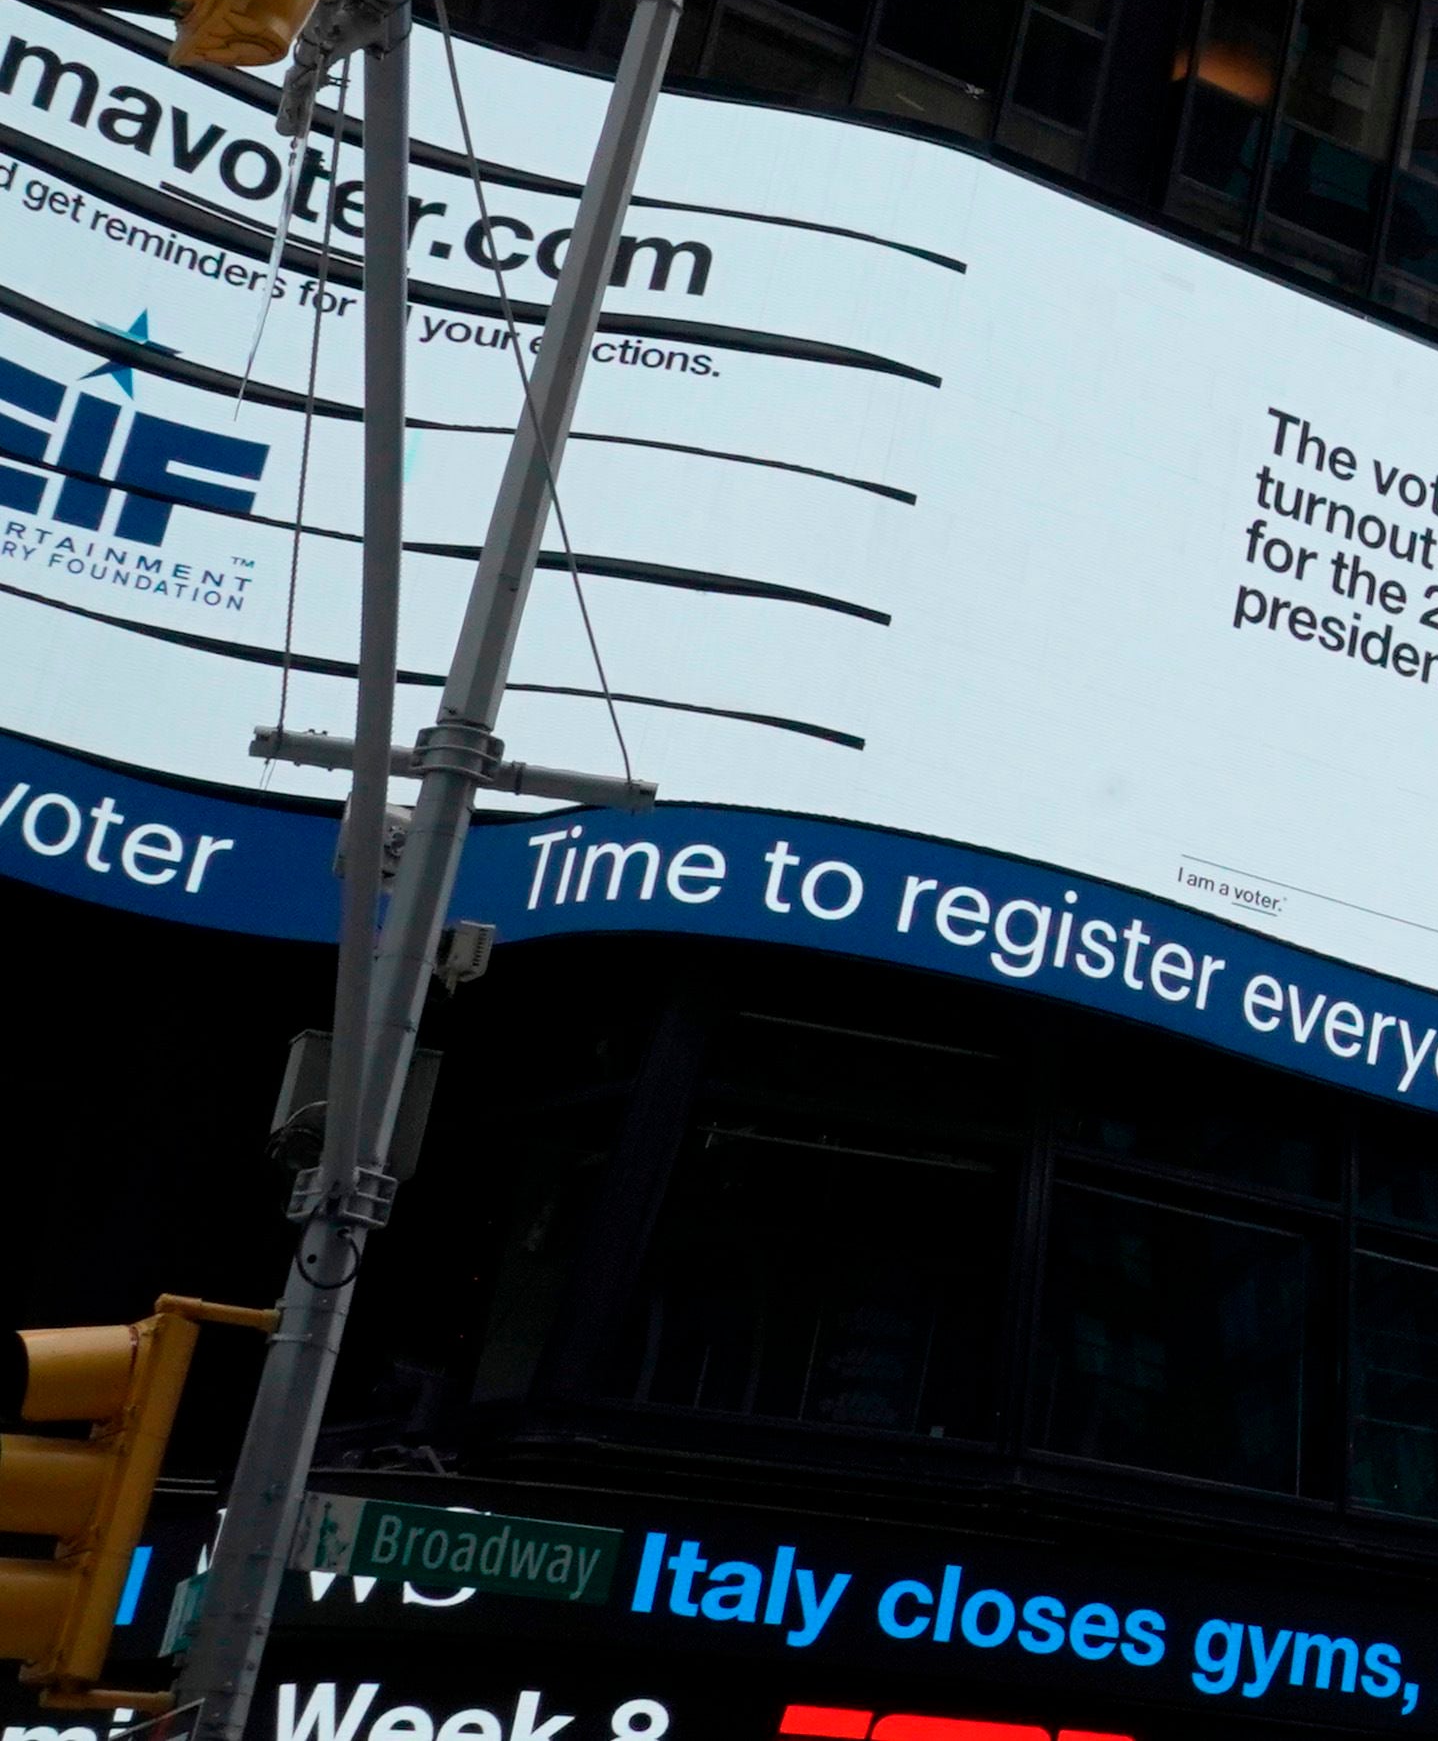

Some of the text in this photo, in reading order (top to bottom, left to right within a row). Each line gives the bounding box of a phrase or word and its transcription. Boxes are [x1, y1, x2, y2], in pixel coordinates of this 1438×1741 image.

[22, 178, 86, 225] get
[90, 209, 288, 299] reminders
[299, 275, 358, 319] for
[418, 312, 522, 353] your
[1266, 406, 1358, 482] The
[1254, 463, 1438, 572] turnout
[48, 552, 245, 612] FOUNDATION
[1244, 518, 1318, 582] for
[1330, 552, 1408, 615] the
[525, 822, 728, 912] Time
[763, 838, 865, 922] to
[895, 889, 1226, 1011] register
[1176, 866, 1184, 883] I
[1186, 872, 1216, 893] am
[1218, 882, 1230, 897] a
[371, 1513, 602, 1601] Broadway
[630, 1530, 853, 1649] Italy
[876, 1564, 1168, 1669] closes
[1191, 1616, 1420, 1717] gyms,
[275, 1681, 576, 1741] Week
